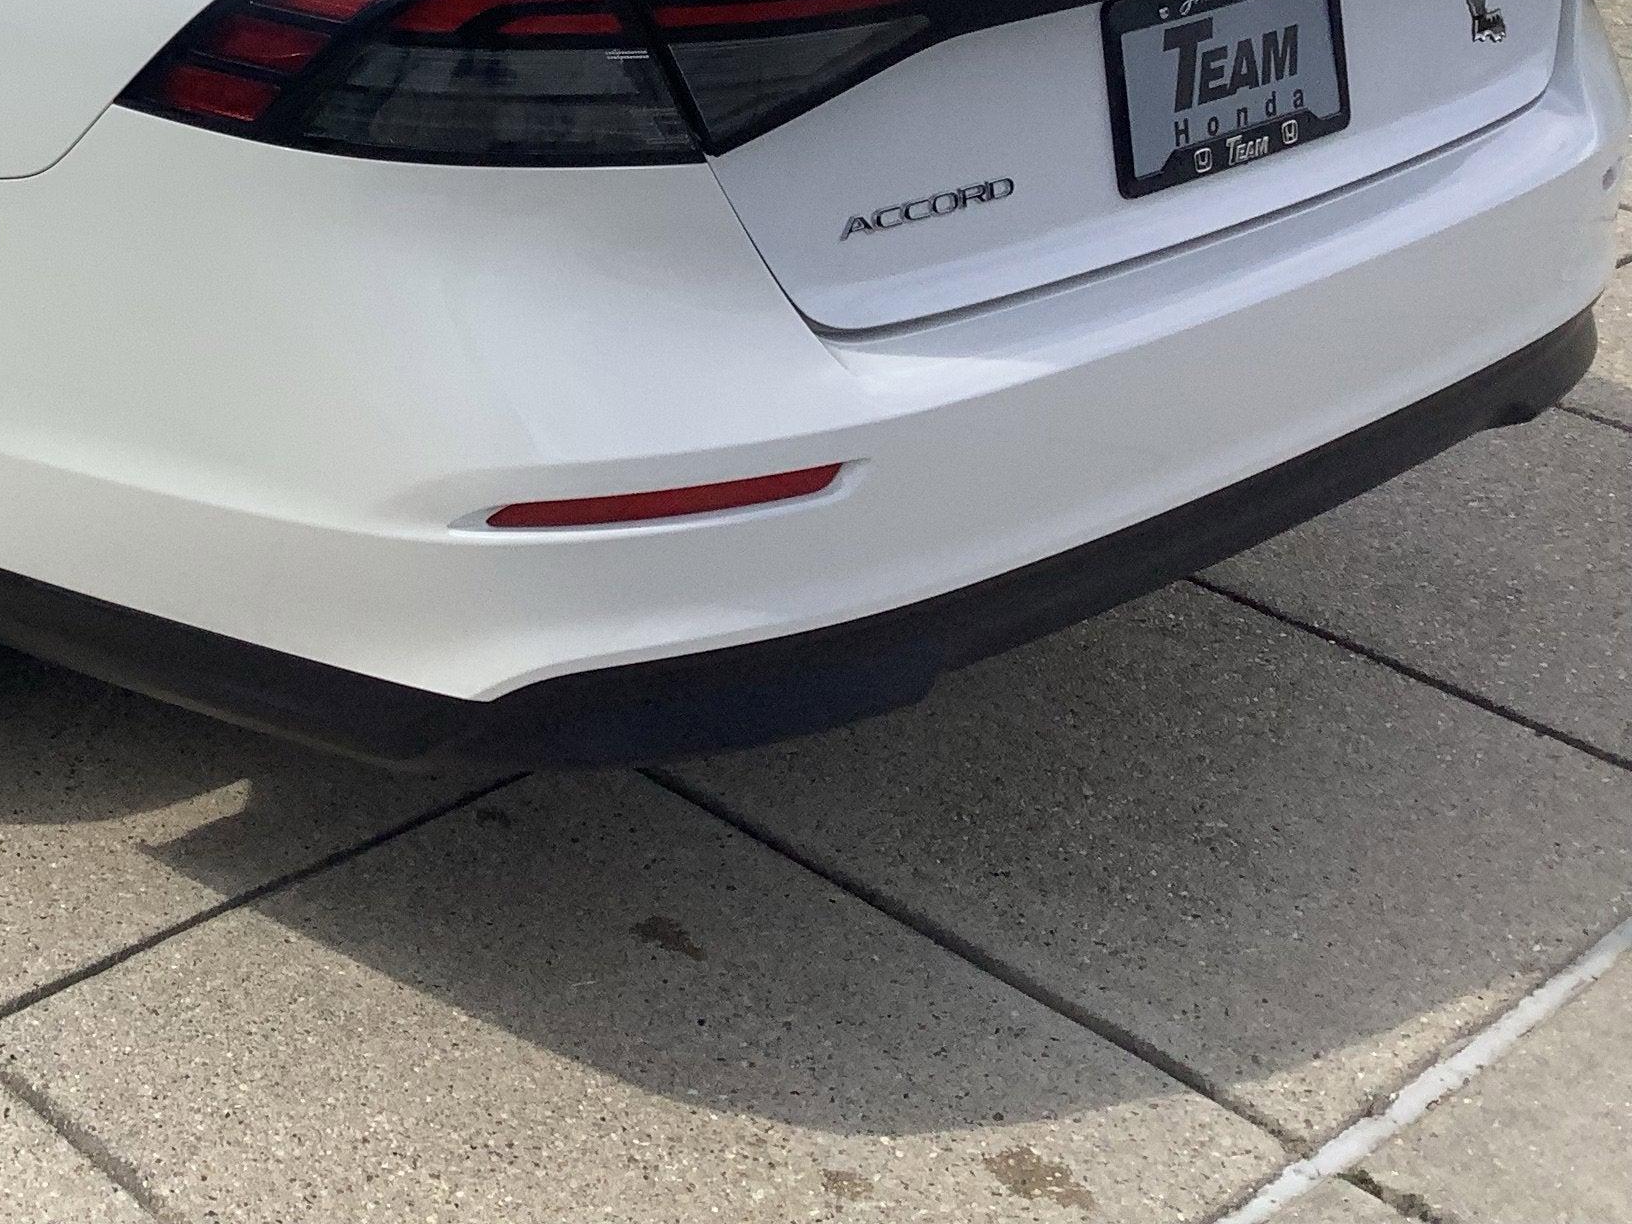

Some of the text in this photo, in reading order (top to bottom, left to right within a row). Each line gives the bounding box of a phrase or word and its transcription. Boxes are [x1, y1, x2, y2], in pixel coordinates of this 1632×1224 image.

[1163, 17, 1298, 113] TEAM
[1174, 88, 1305, 147] Honda
[1226, 134, 1269, 166] TEAM
[839, 177, 1015, 242] ACCORD
